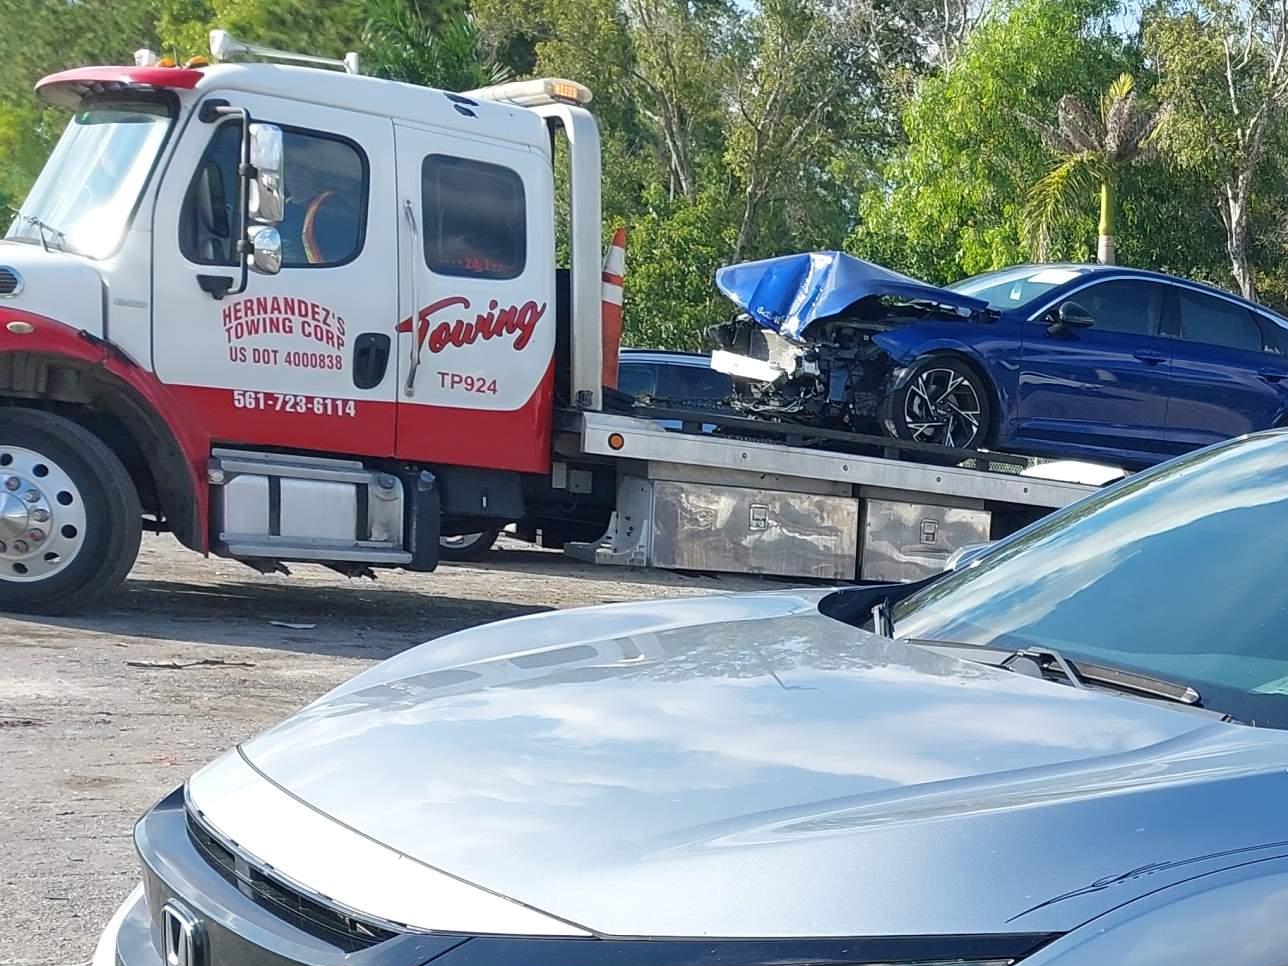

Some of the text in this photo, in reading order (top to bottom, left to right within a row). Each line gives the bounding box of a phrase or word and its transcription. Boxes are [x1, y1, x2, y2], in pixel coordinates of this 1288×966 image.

[222, 296, 346, 337] HERNANDEZ'S
[395, 296, 547, 364] Towing
[225, 316, 345, 351] TOWING CORP
[229, 346, 343, 370] US DOT 4000838
[437, 371, 498, 395] TP924
[232, 389, 357, 417] 561-723-6114
